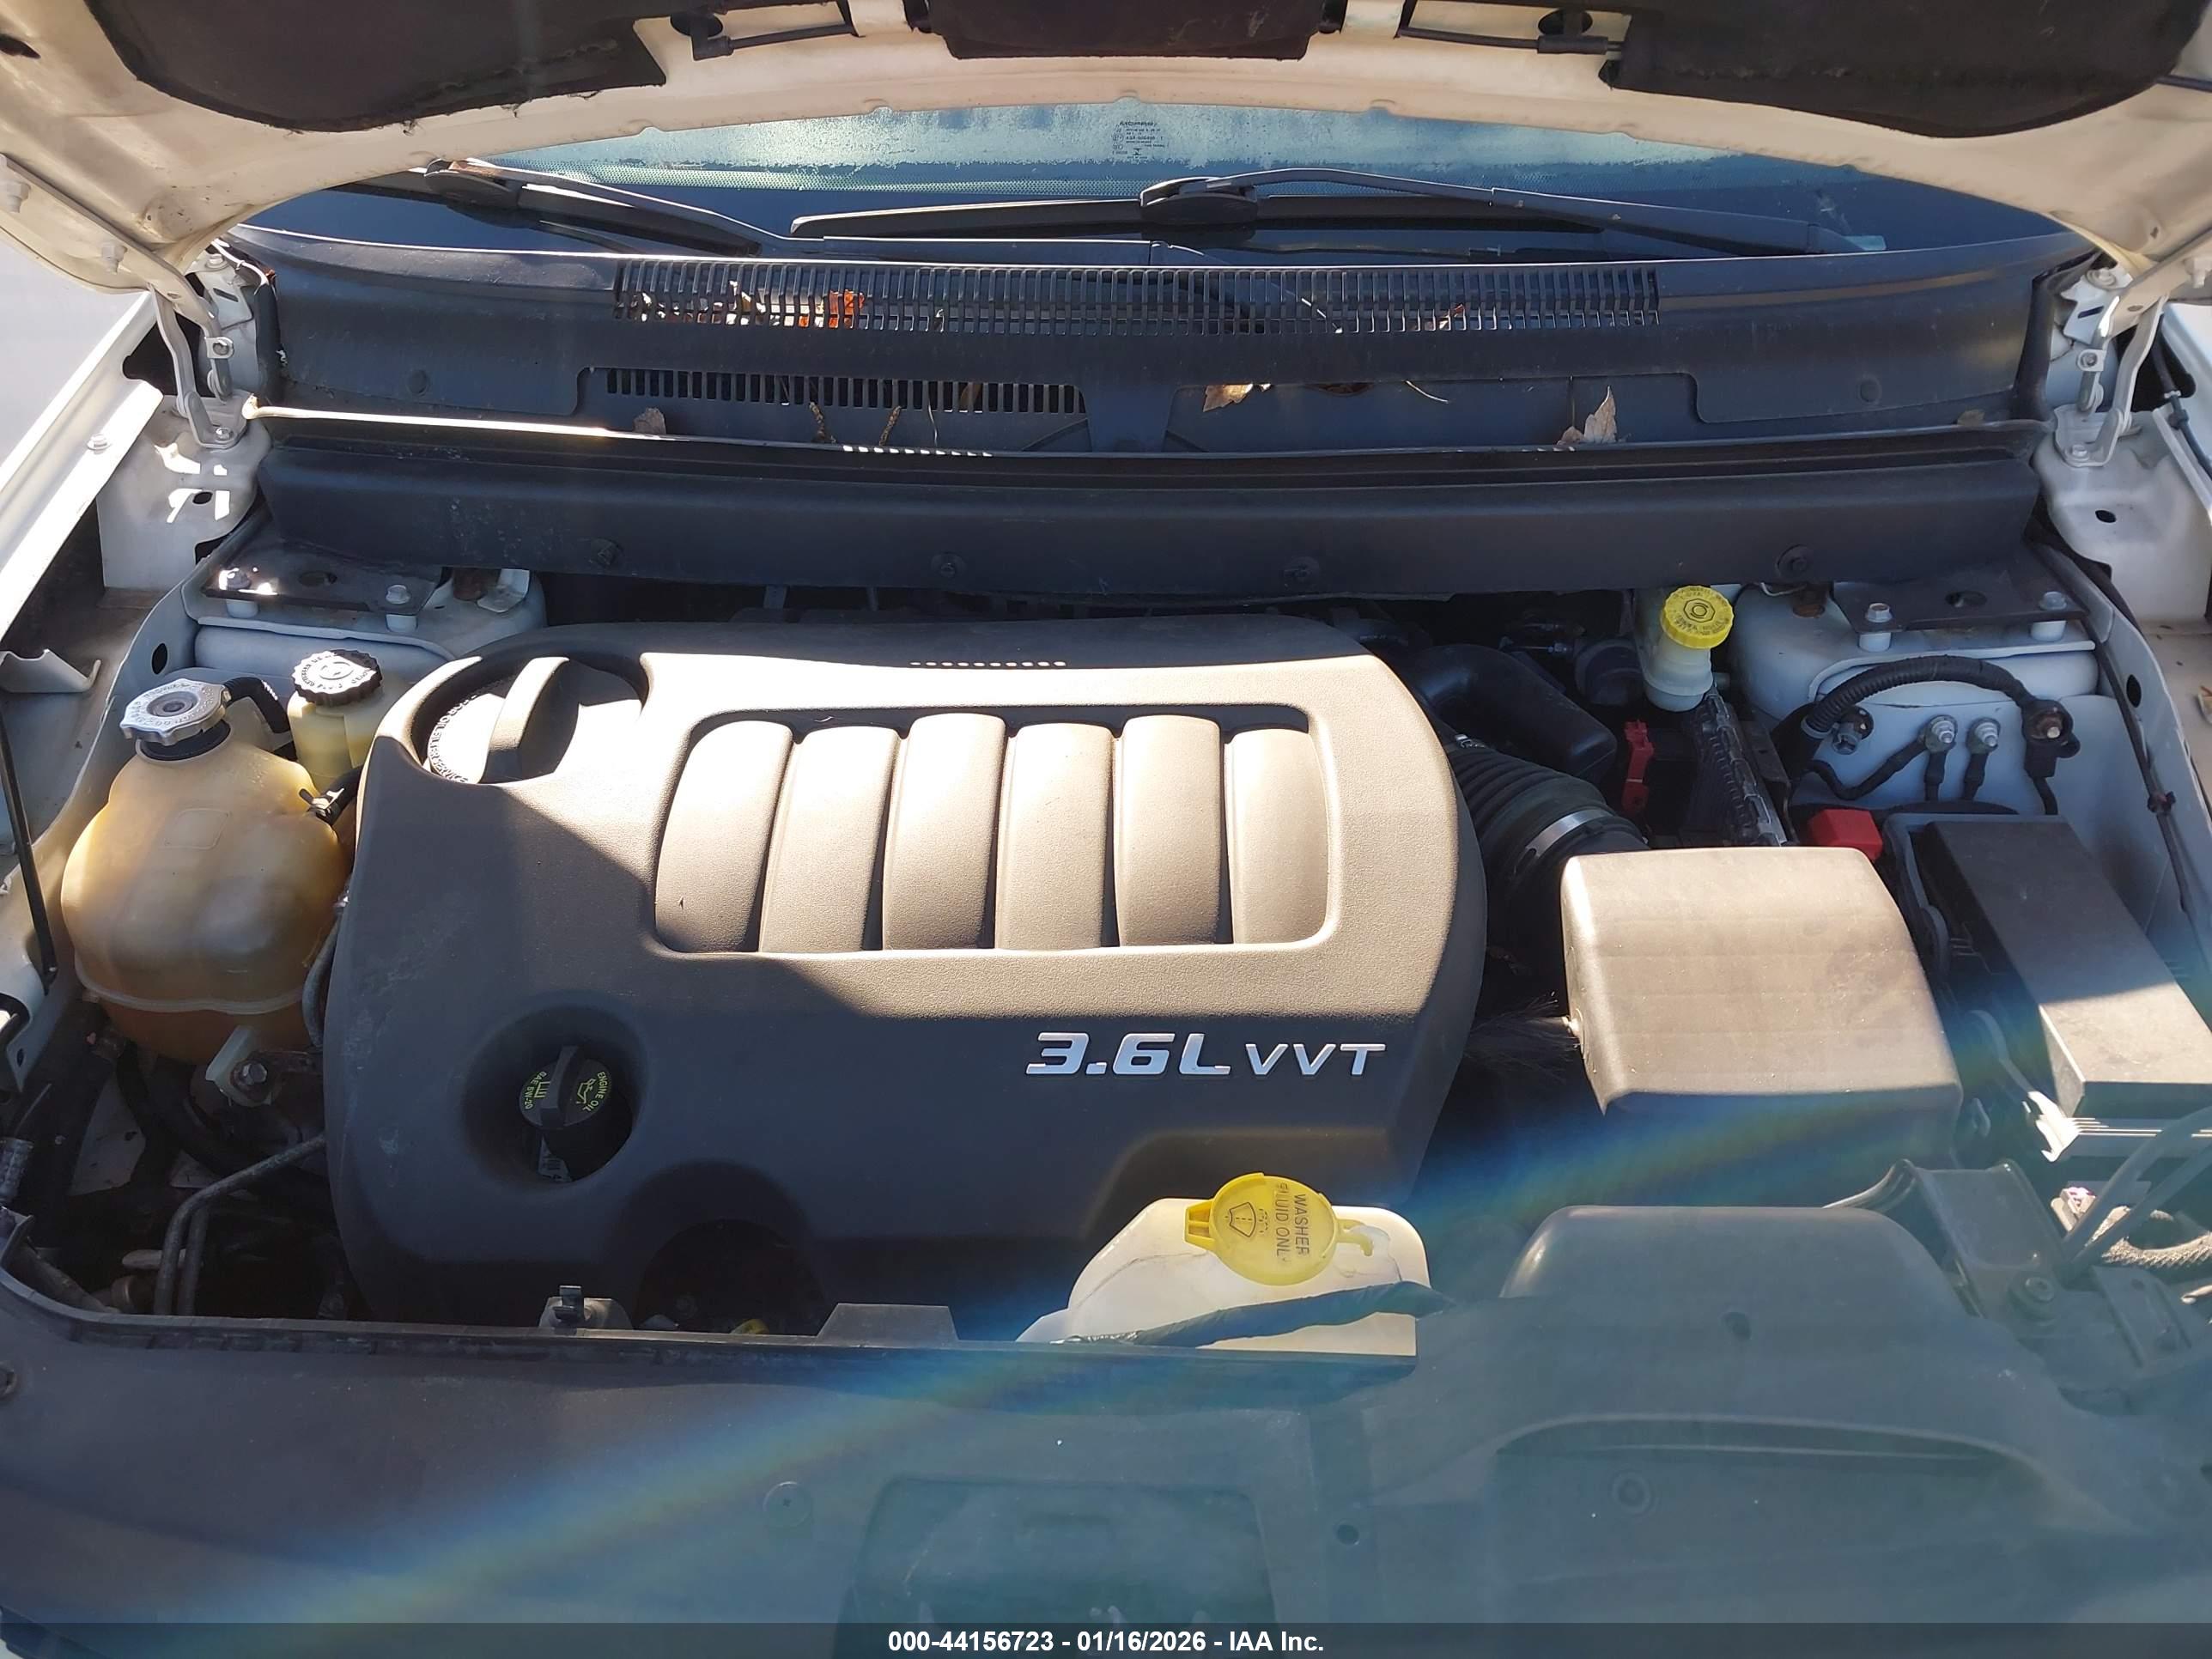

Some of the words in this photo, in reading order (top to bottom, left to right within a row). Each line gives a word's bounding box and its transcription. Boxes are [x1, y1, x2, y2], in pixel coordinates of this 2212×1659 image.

[1025, 1032, 1231, 1075] 3.6L
[1246, 1043, 1386, 1075] VVT
[523, 1086, 534, 1109] 5W-20
[596, 1071, 608, 1099] ENGINE
[582, 1100, 599, 1112] OIL
